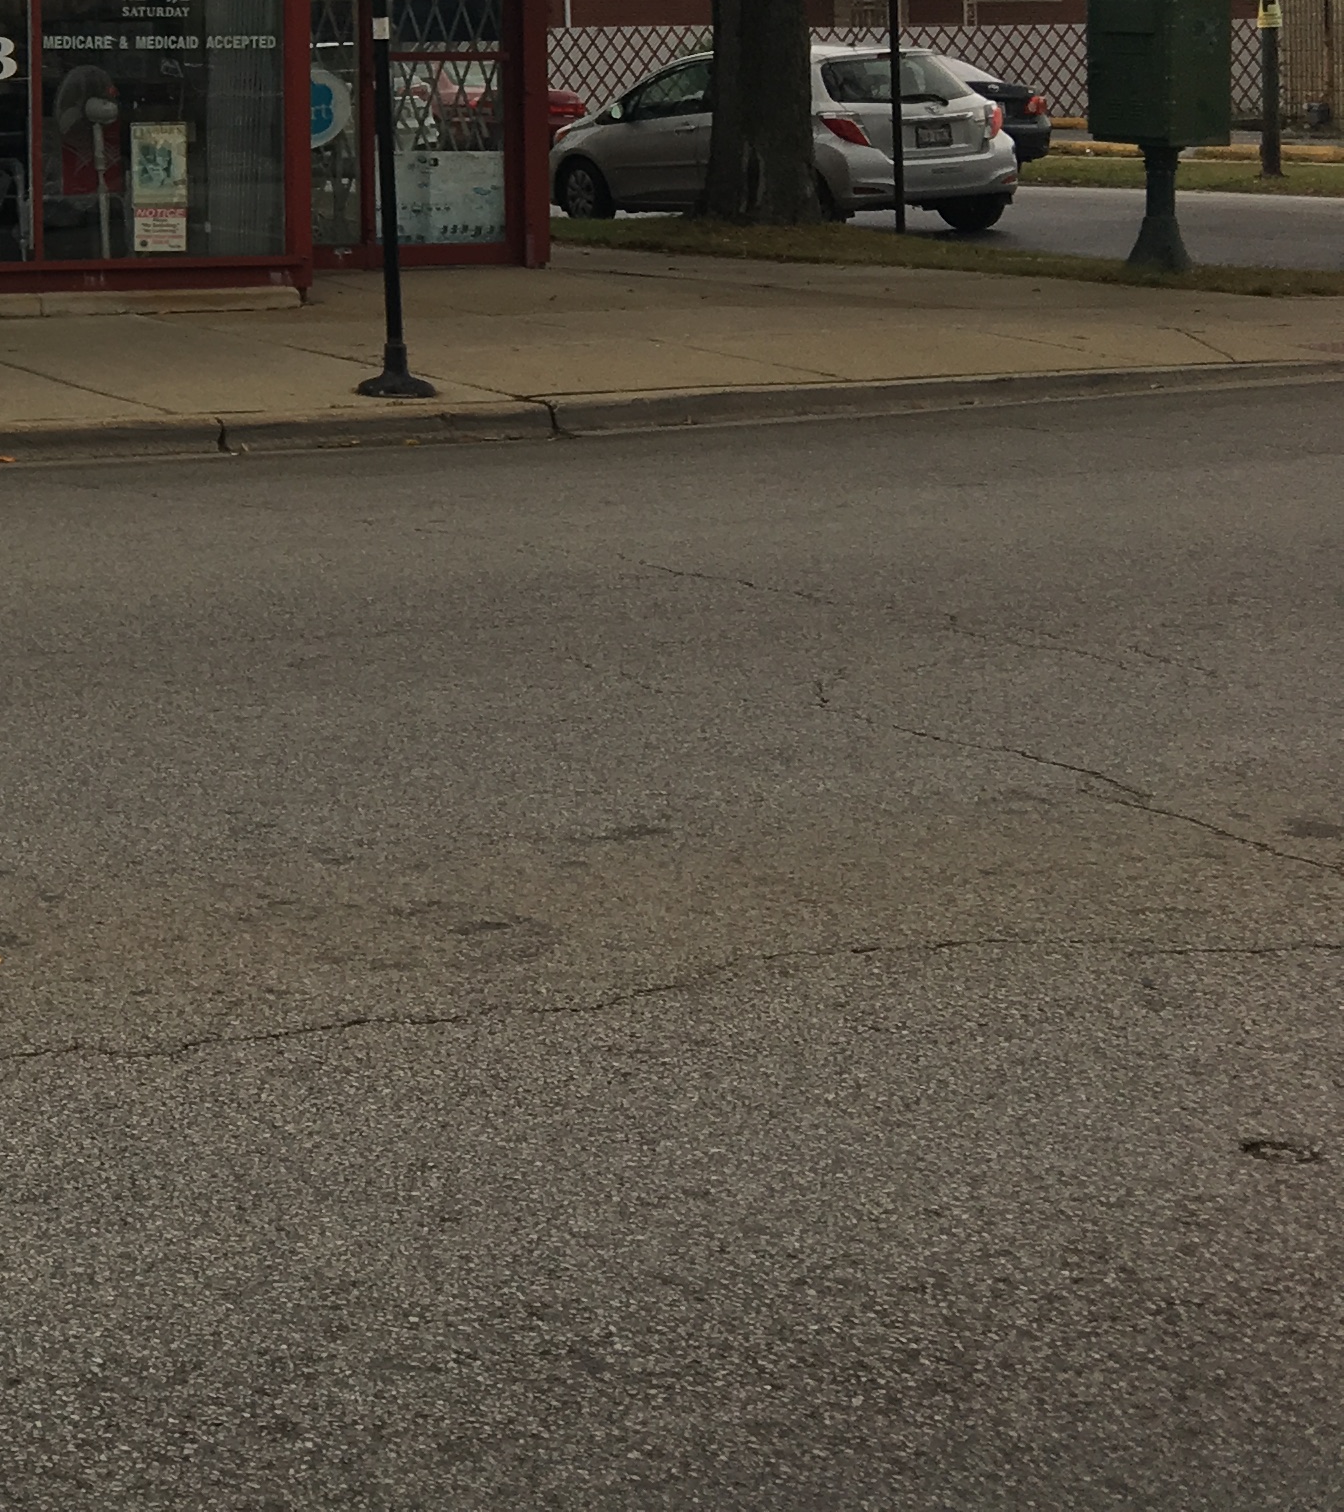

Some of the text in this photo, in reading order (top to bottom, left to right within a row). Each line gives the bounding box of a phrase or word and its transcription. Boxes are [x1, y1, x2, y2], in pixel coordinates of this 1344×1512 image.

[122, 6, 190, 17] SATURDAY
[43, 36, 277, 49] MEDICARE & MEDICAID ACCEPTED
[135, 208, 185, 218] NOTICE
